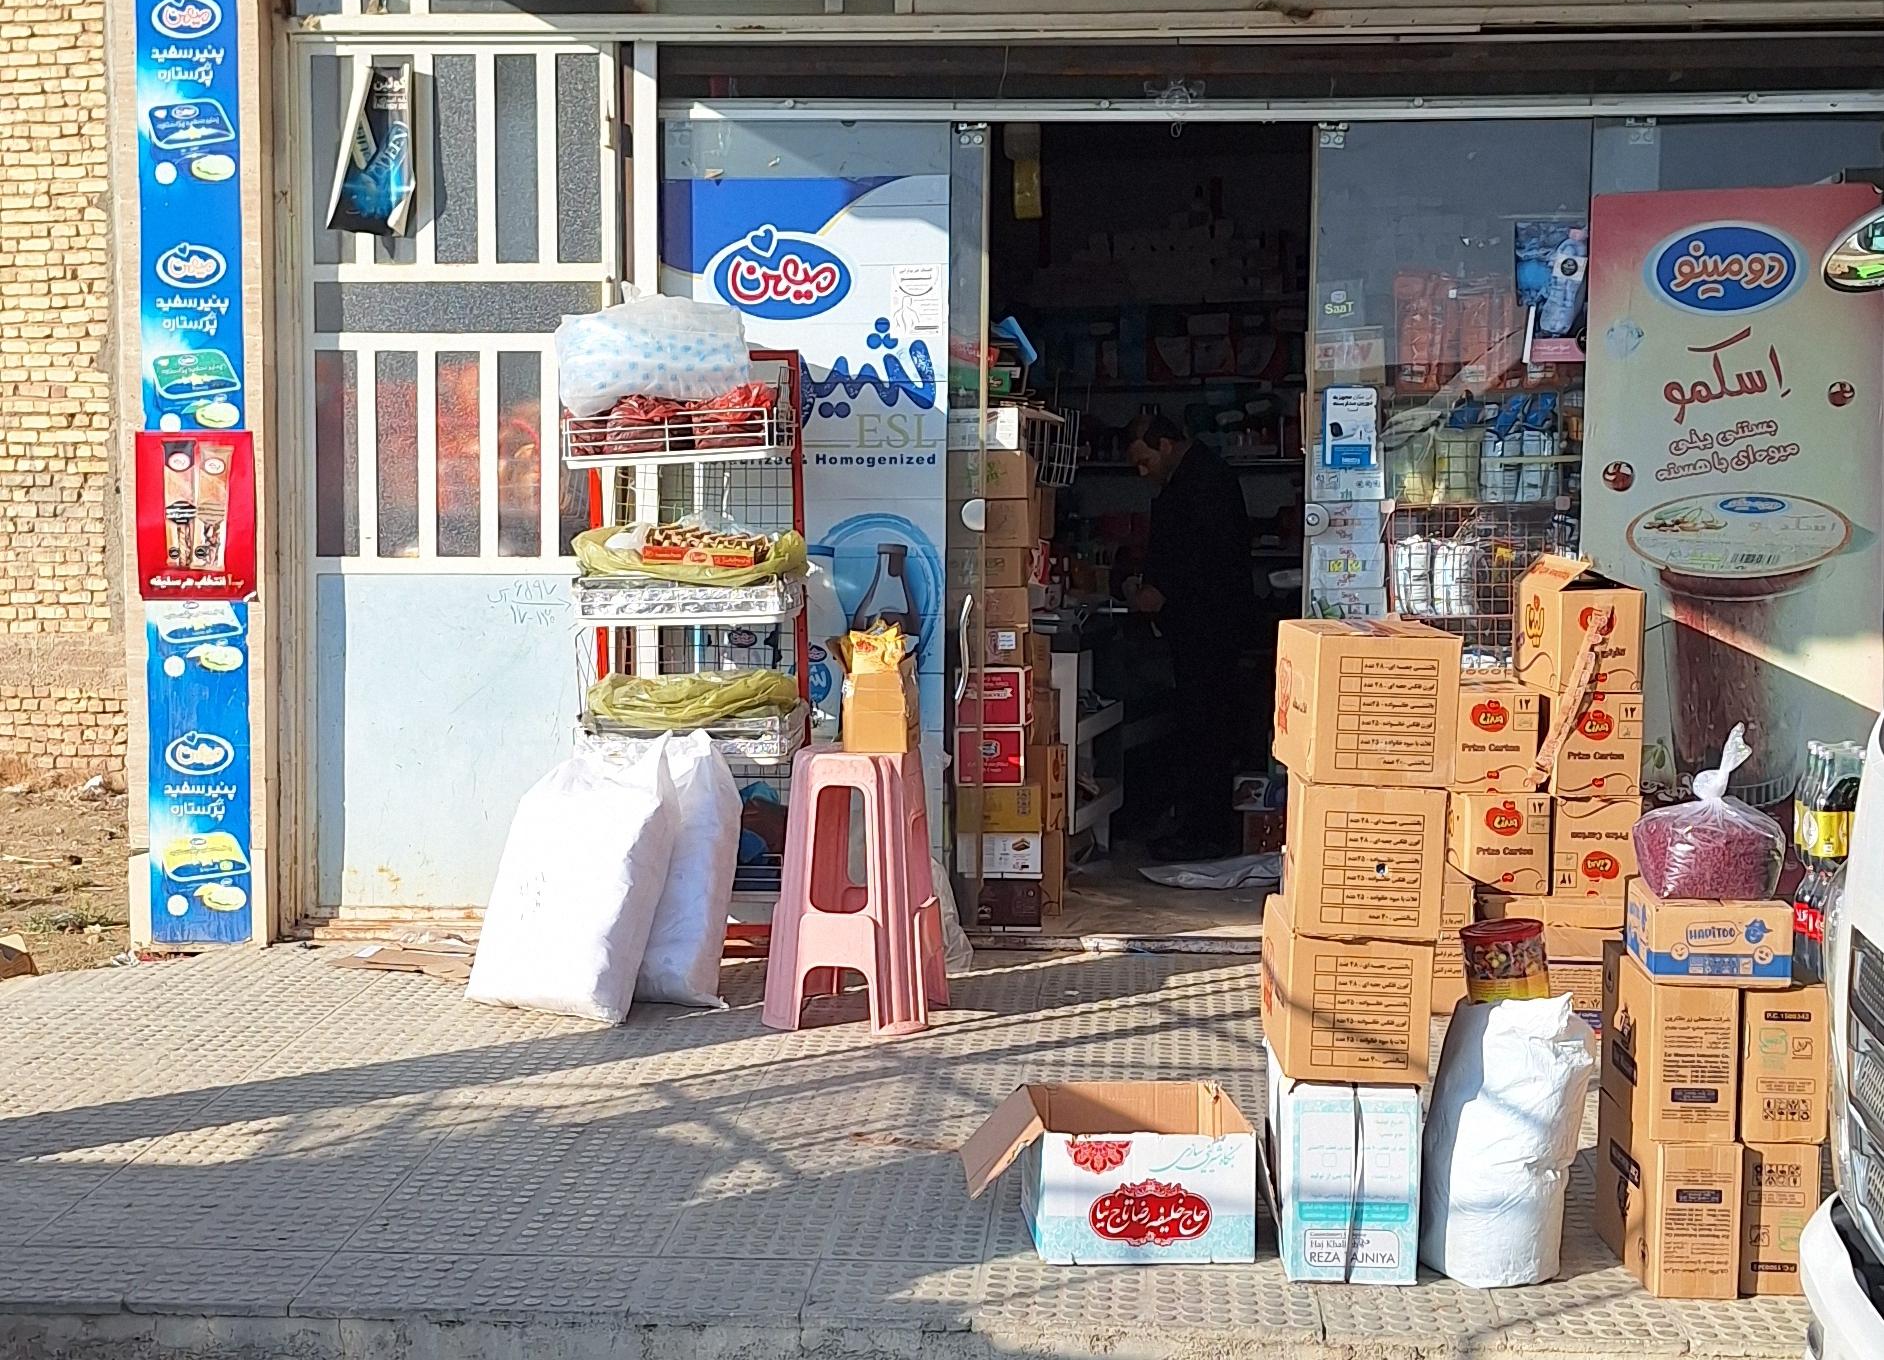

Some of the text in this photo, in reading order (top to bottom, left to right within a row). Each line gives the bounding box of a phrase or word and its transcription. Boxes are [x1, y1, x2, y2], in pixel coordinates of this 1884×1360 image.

[729, 254, 838, 303] میهن
[1670, 239, 1788, 299] دومینو
[856, 413, 938, 449] ESL
[1669, 420, 1778, 456] بستنی یخی
[815, 453, 937, 467] Homogenized
[1656, 459, 1712, 481] هسته
[1712, 451, 1729, 473] با
[1131, 1200, 1150, 1225] رضا
[1146, 1198, 1185, 1233] خلیفه
[1179, 1205, 1208, 1236] حاج
[1310, 1251, 1396, 1263] REZA AJNIYA
